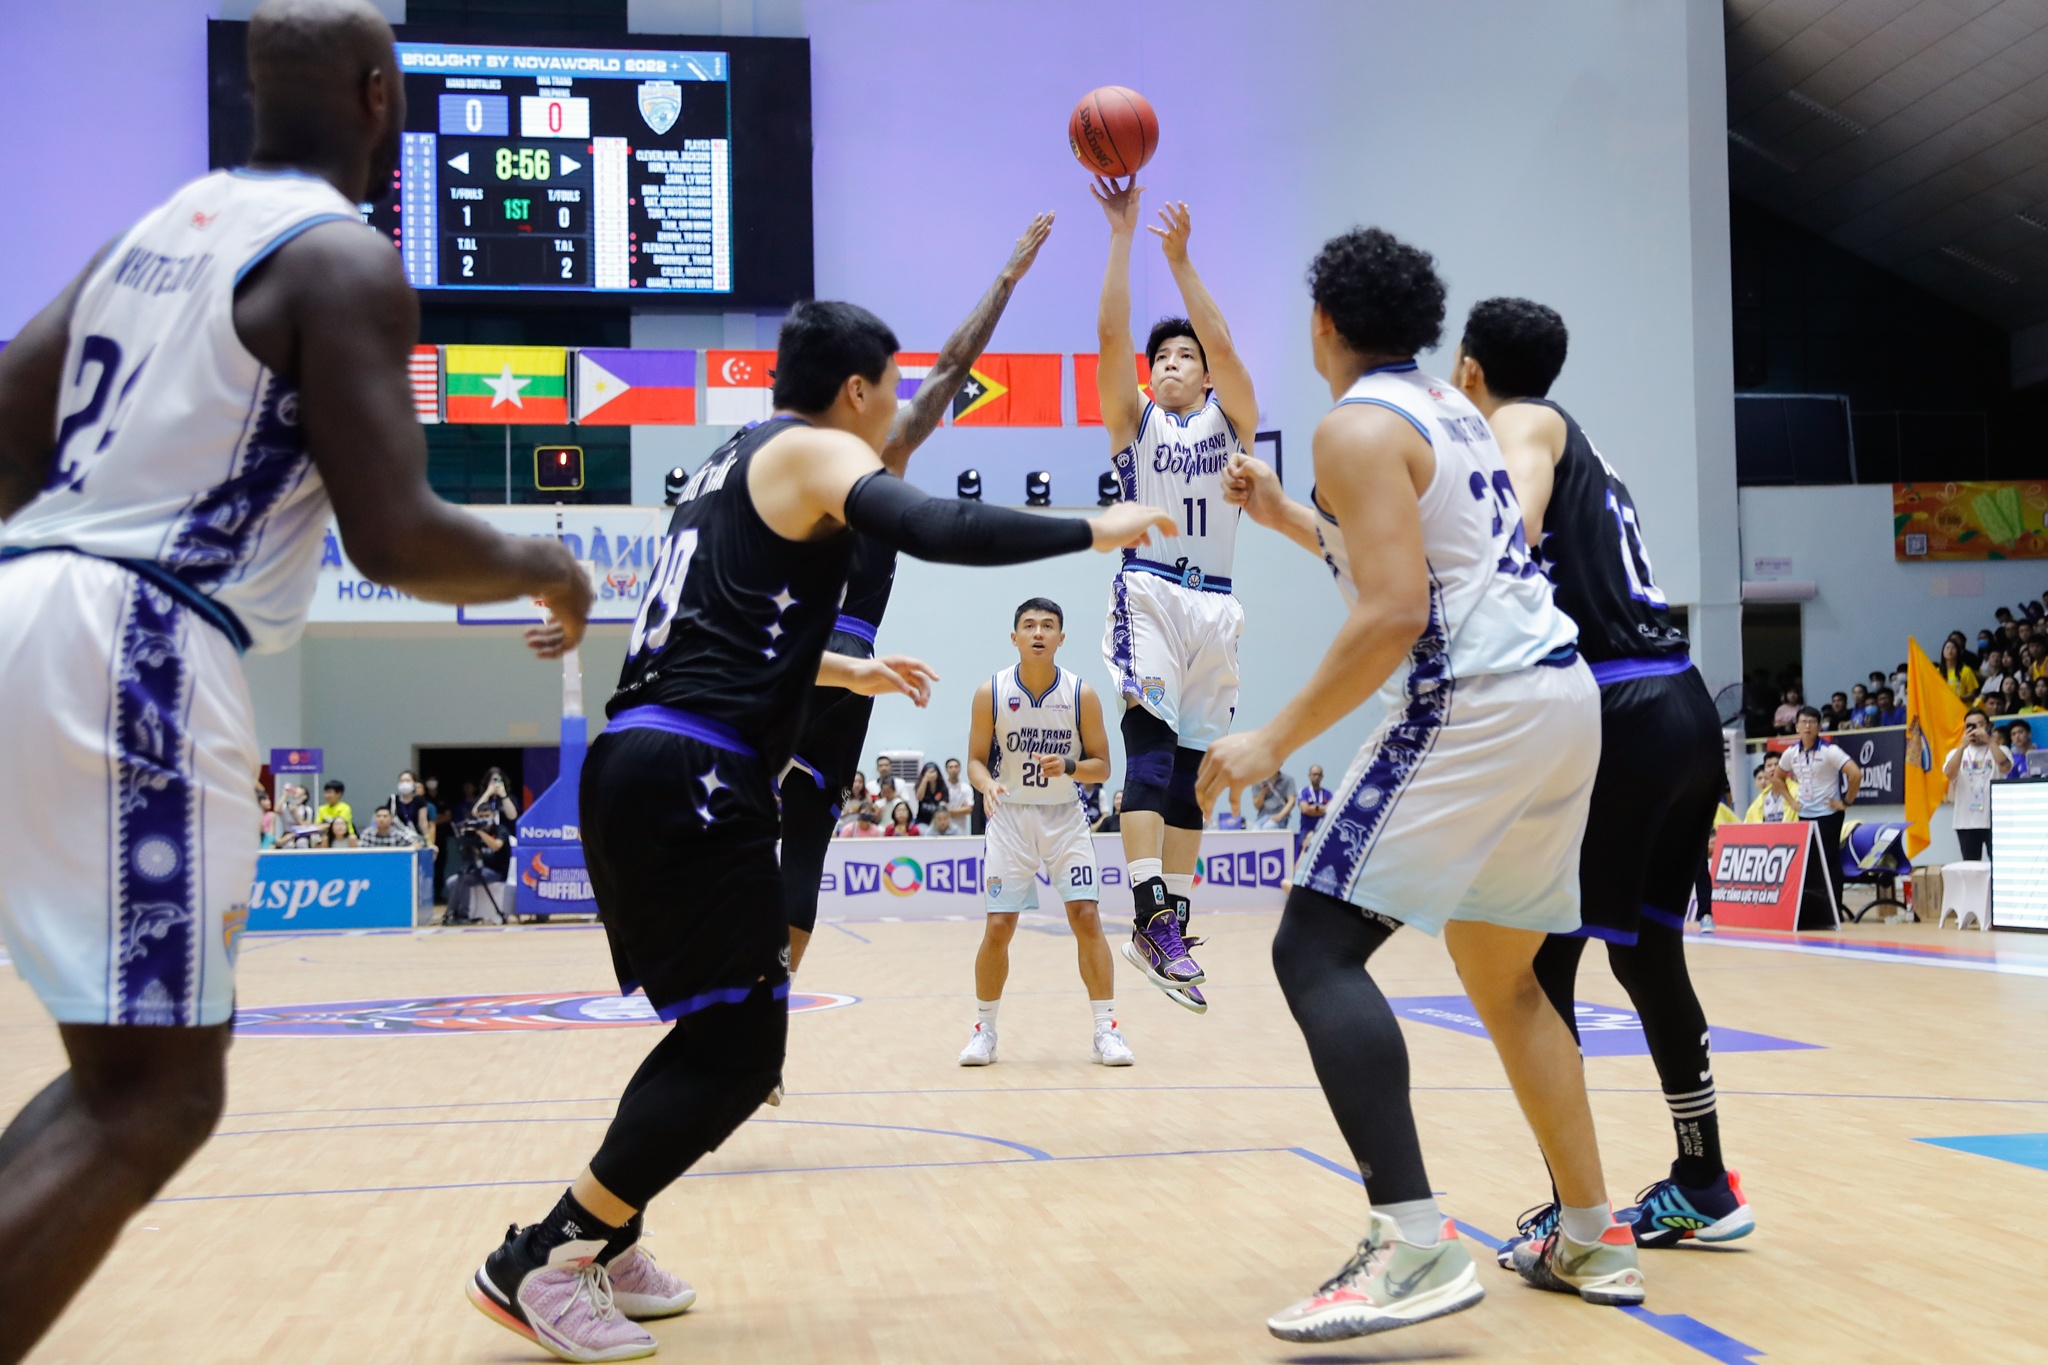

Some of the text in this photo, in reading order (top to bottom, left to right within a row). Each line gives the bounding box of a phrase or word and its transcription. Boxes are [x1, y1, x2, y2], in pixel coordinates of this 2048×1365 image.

[402, 53, 667, 73] BROUGHT BY NOVAWORLD 2022
[465, 99, 483, 132] 0
[549, 102, 563, 132] 0
[496, 148, 551, 180] 8:56
[450, 187, 484, 200] T/FOULS
[547, 189, 580, 202] T/FOULS
[462, 205, 471, 226] 1
[503, 199, 531, 220] 1ST
[558, 207, 570, 228] 0
[462, 255, 474, 277] 2
[561, 257, 573, 278] 2
[1183, 497, 1207, 537] 11
[1020, 727, 1072, 739] NHA TRANG
[1007, 731, 1071, 759] Dolphins
[1071, 866, 1092, 886] 20
[1715, 845, 1798, 886] ENERGY
[249, 878, 371, 919] asper
[537, 880, 595, 900] BUFFALO
